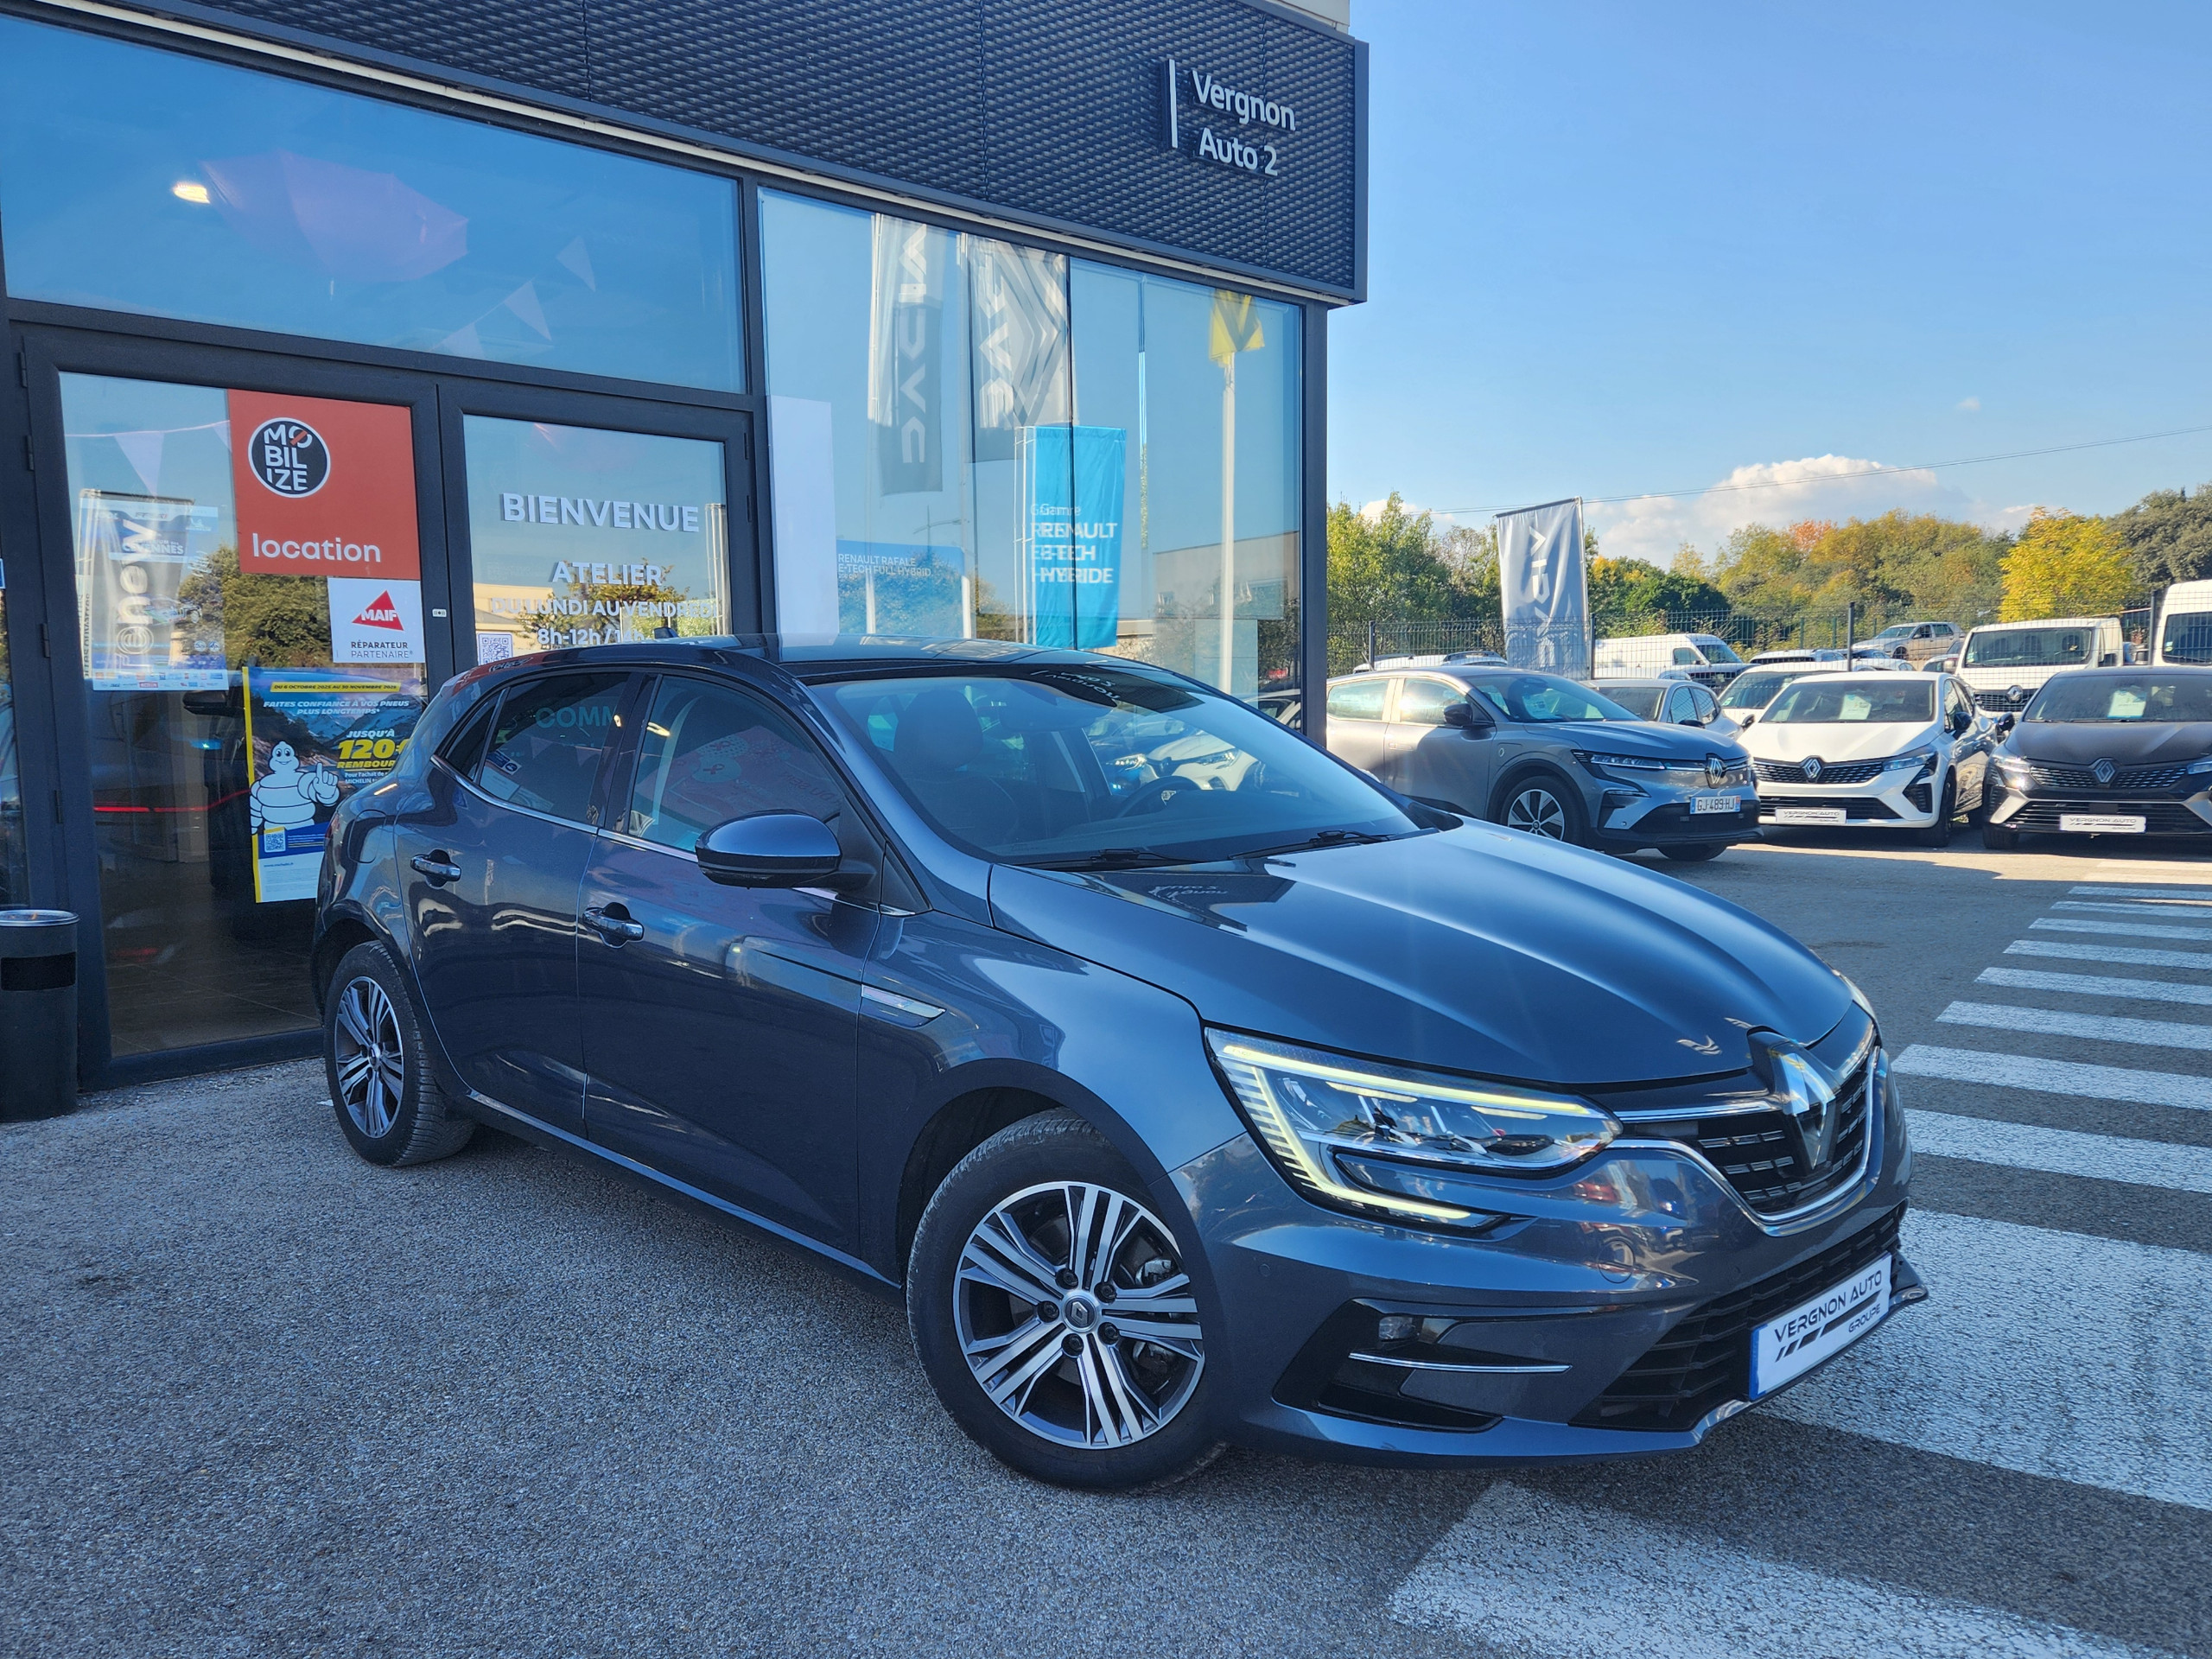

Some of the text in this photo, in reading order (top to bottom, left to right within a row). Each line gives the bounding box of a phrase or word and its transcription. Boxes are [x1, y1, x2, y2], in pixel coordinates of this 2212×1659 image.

[1191, 70, 1295, 130] Vergnon
[1199, 128, 1278, 176] Auto 2
[265, 445, 307, 469] BIL
[267, 467, 308, 491] IZE
[502, 493, 700, 532] BIENVENUE
[252, 532, 380, 563] location
[838, 554, 916, 567] RENAULT RAFALE
[838, 563, 931, 576] E-TECH FULL HYBRID
[551, 562, 662, 586] ATELIER
[361, 609, 397, 621] MAIF
[492, 598, 719, 619] DU LUNDI AU VENDREDI
[351, 639, 408, 649] RÉPARATEUR
[537, 628, 600, 645] 8h-12h
[346, 728, 395, 739] JUSQU'À
[1774, 1270, 1882, 1343] VERGNON AUTO
[1848, 1304, 1881, 1333] GROUPE
